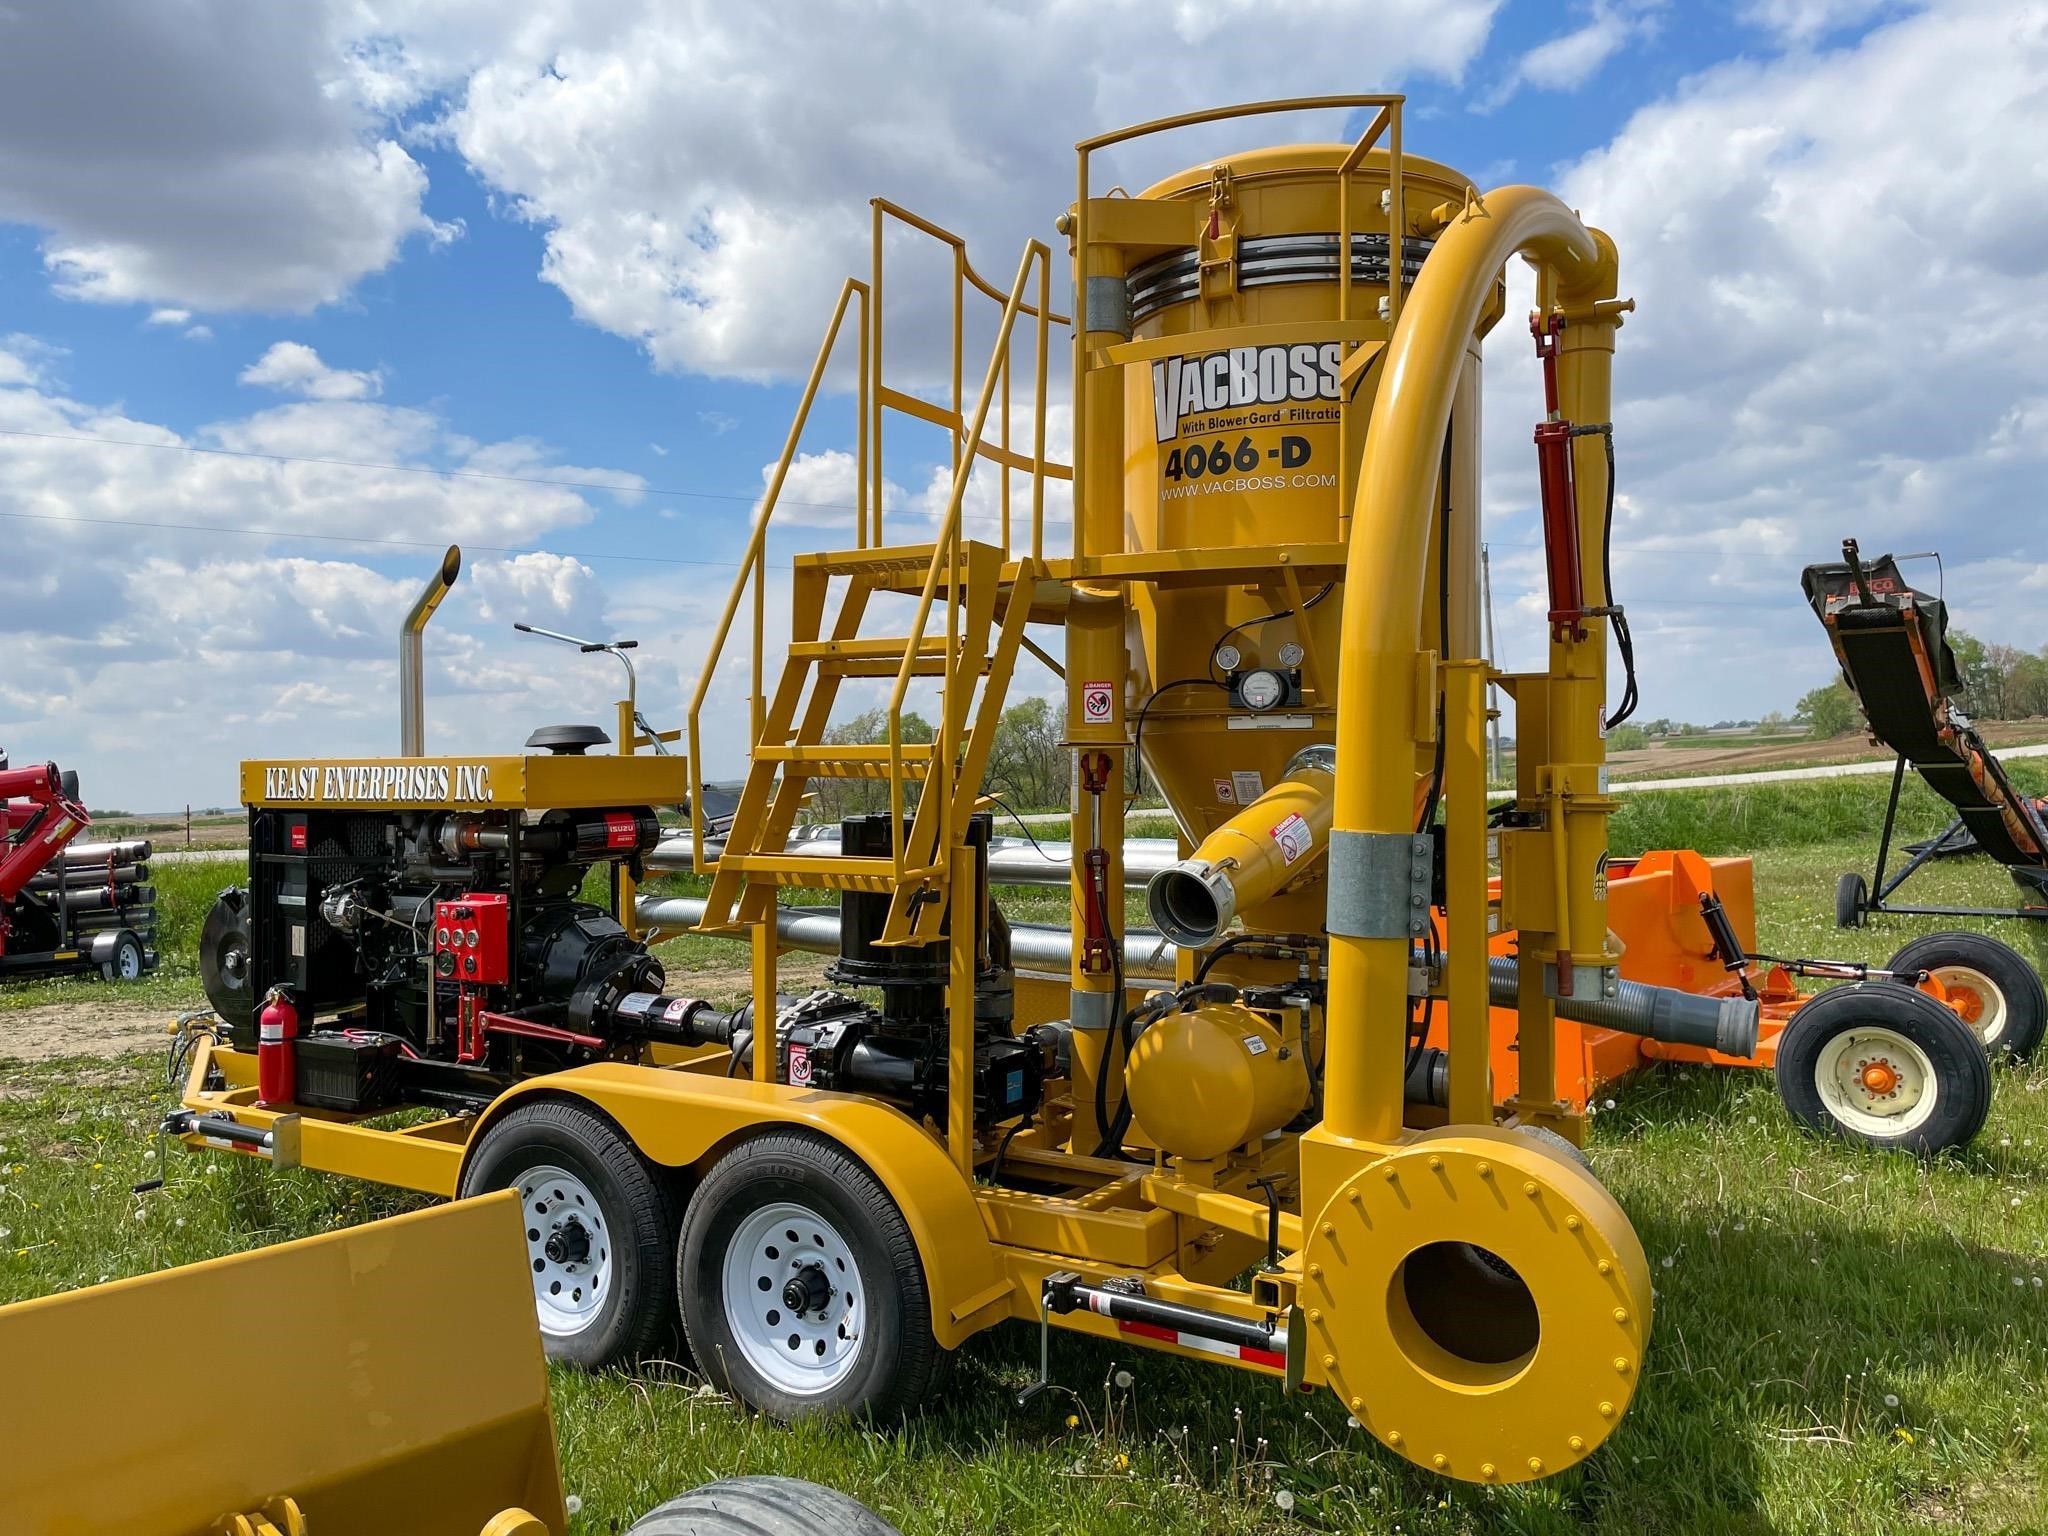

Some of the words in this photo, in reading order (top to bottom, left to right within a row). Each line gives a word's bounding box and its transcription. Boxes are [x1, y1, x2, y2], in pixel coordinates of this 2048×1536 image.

[1182, 420, 1205, 434] With
[1289, 407, 1341, 421] Filtratio
[264, 767, 319, 801] KEAST
[322, 765, 449, 801] ENTERPRISES
[454, 764, 493, 802] INC.
[1276, 814, 1298, 832] DANGER
